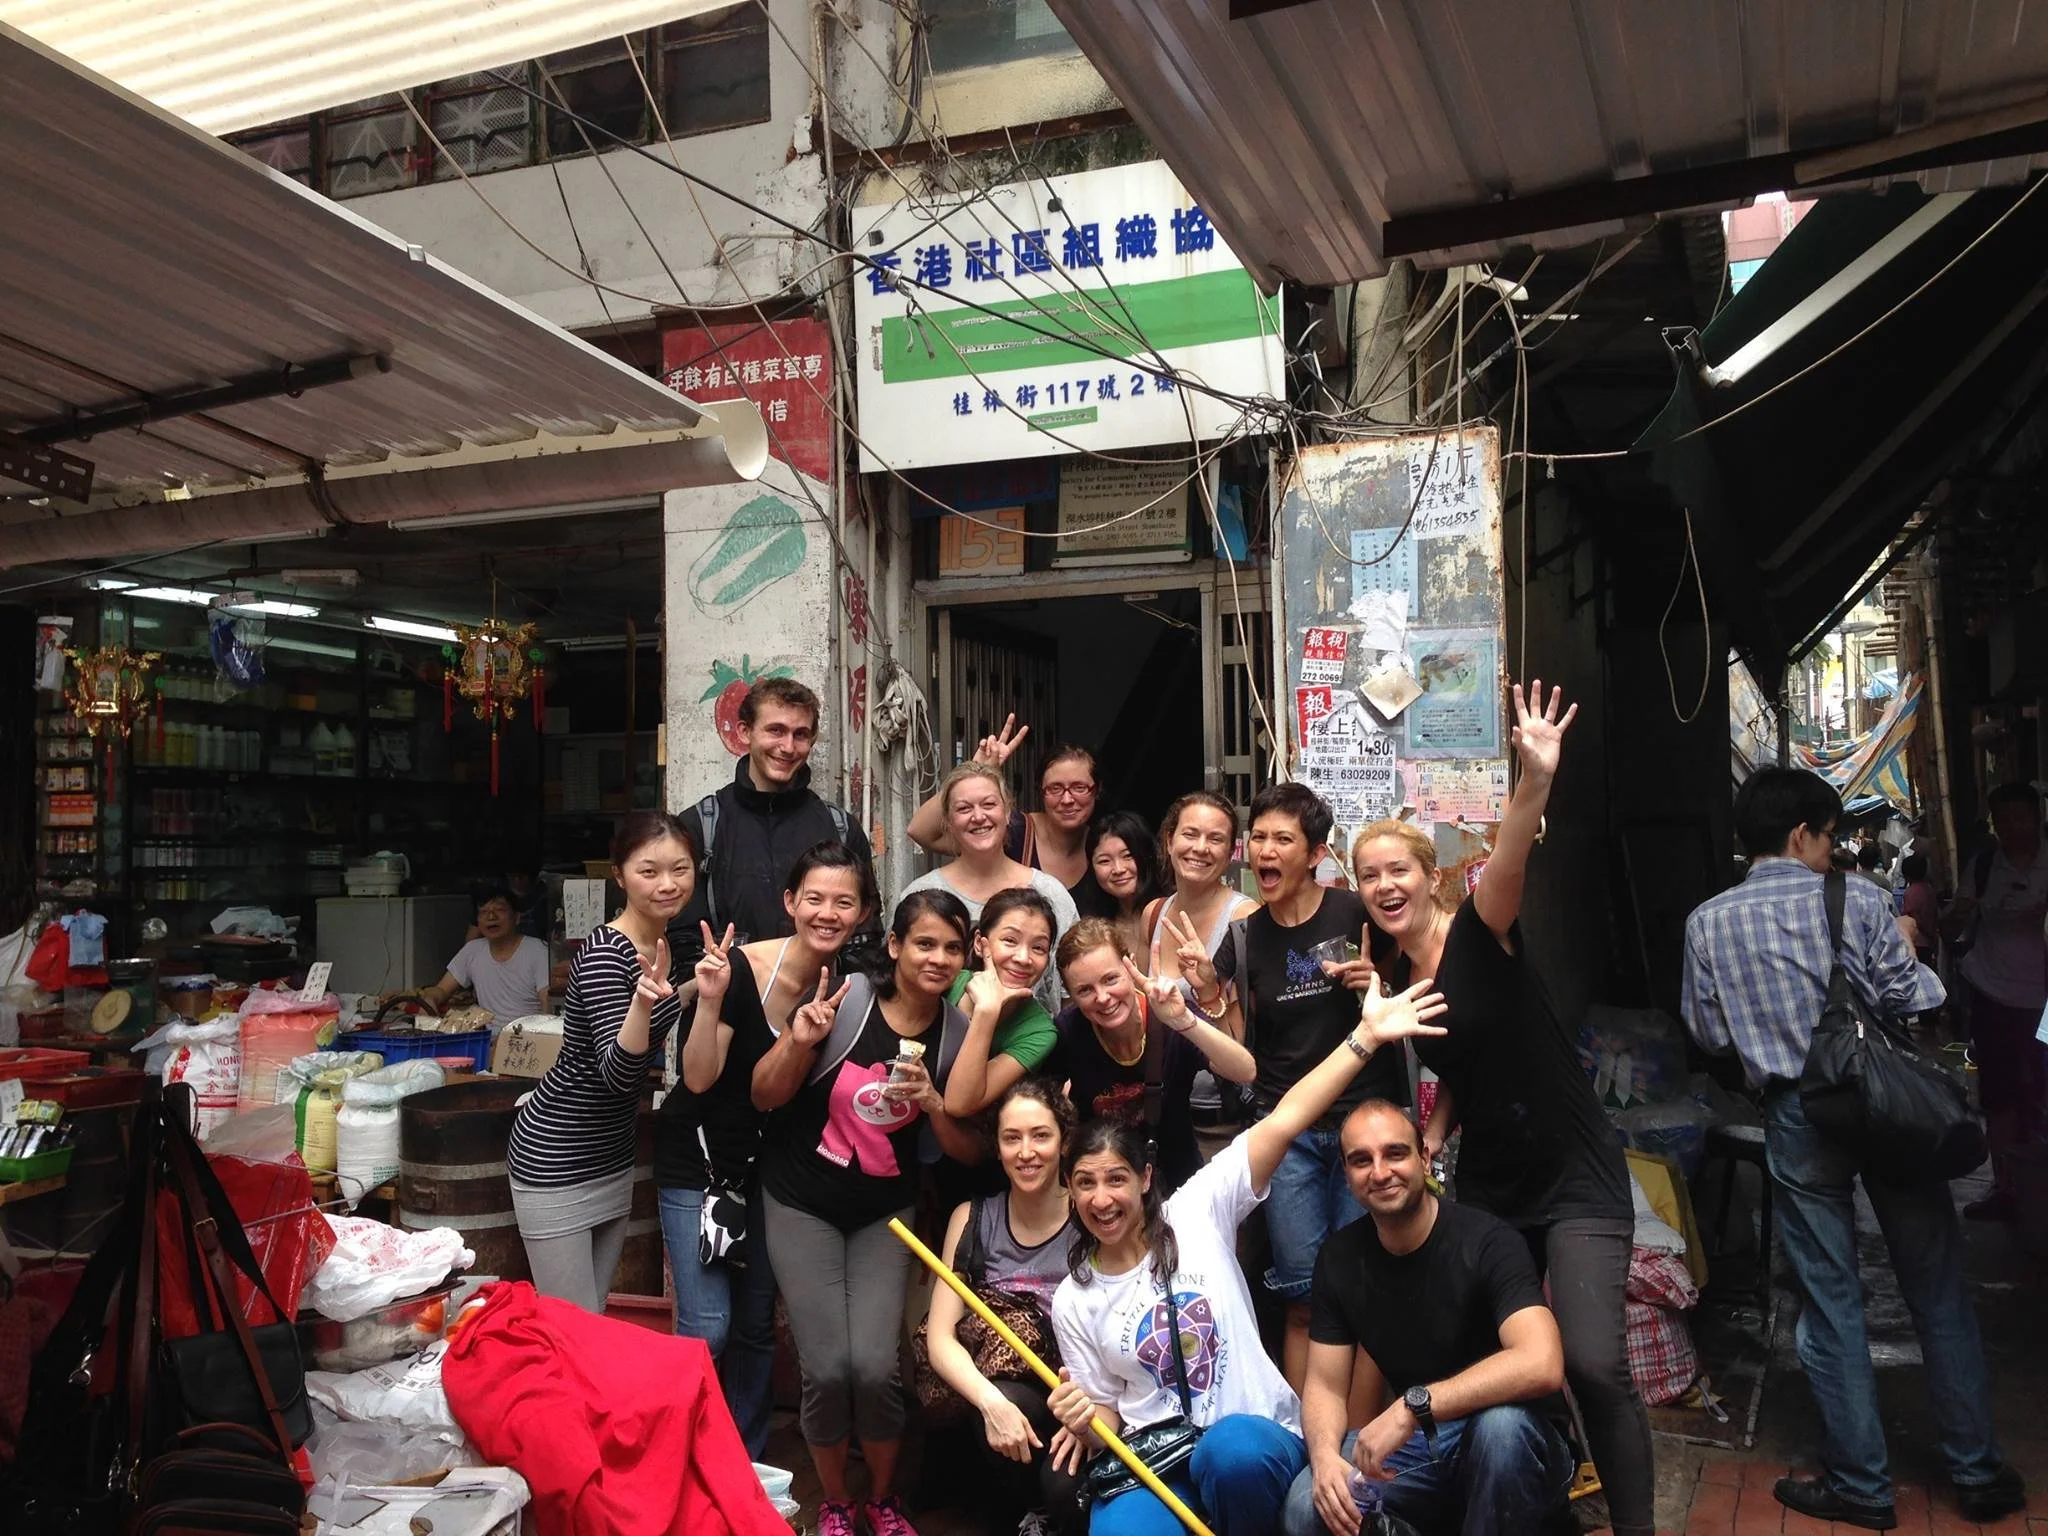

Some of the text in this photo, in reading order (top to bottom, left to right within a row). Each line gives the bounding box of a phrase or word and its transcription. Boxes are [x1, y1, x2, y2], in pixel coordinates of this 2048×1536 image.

[1302, 672, 1318, 681] 272
[1302, 690, 1331, 717] 報
[1340, 769, 1391, 780] 63029209
[1177, 1273, 1206, 1287] ONE
